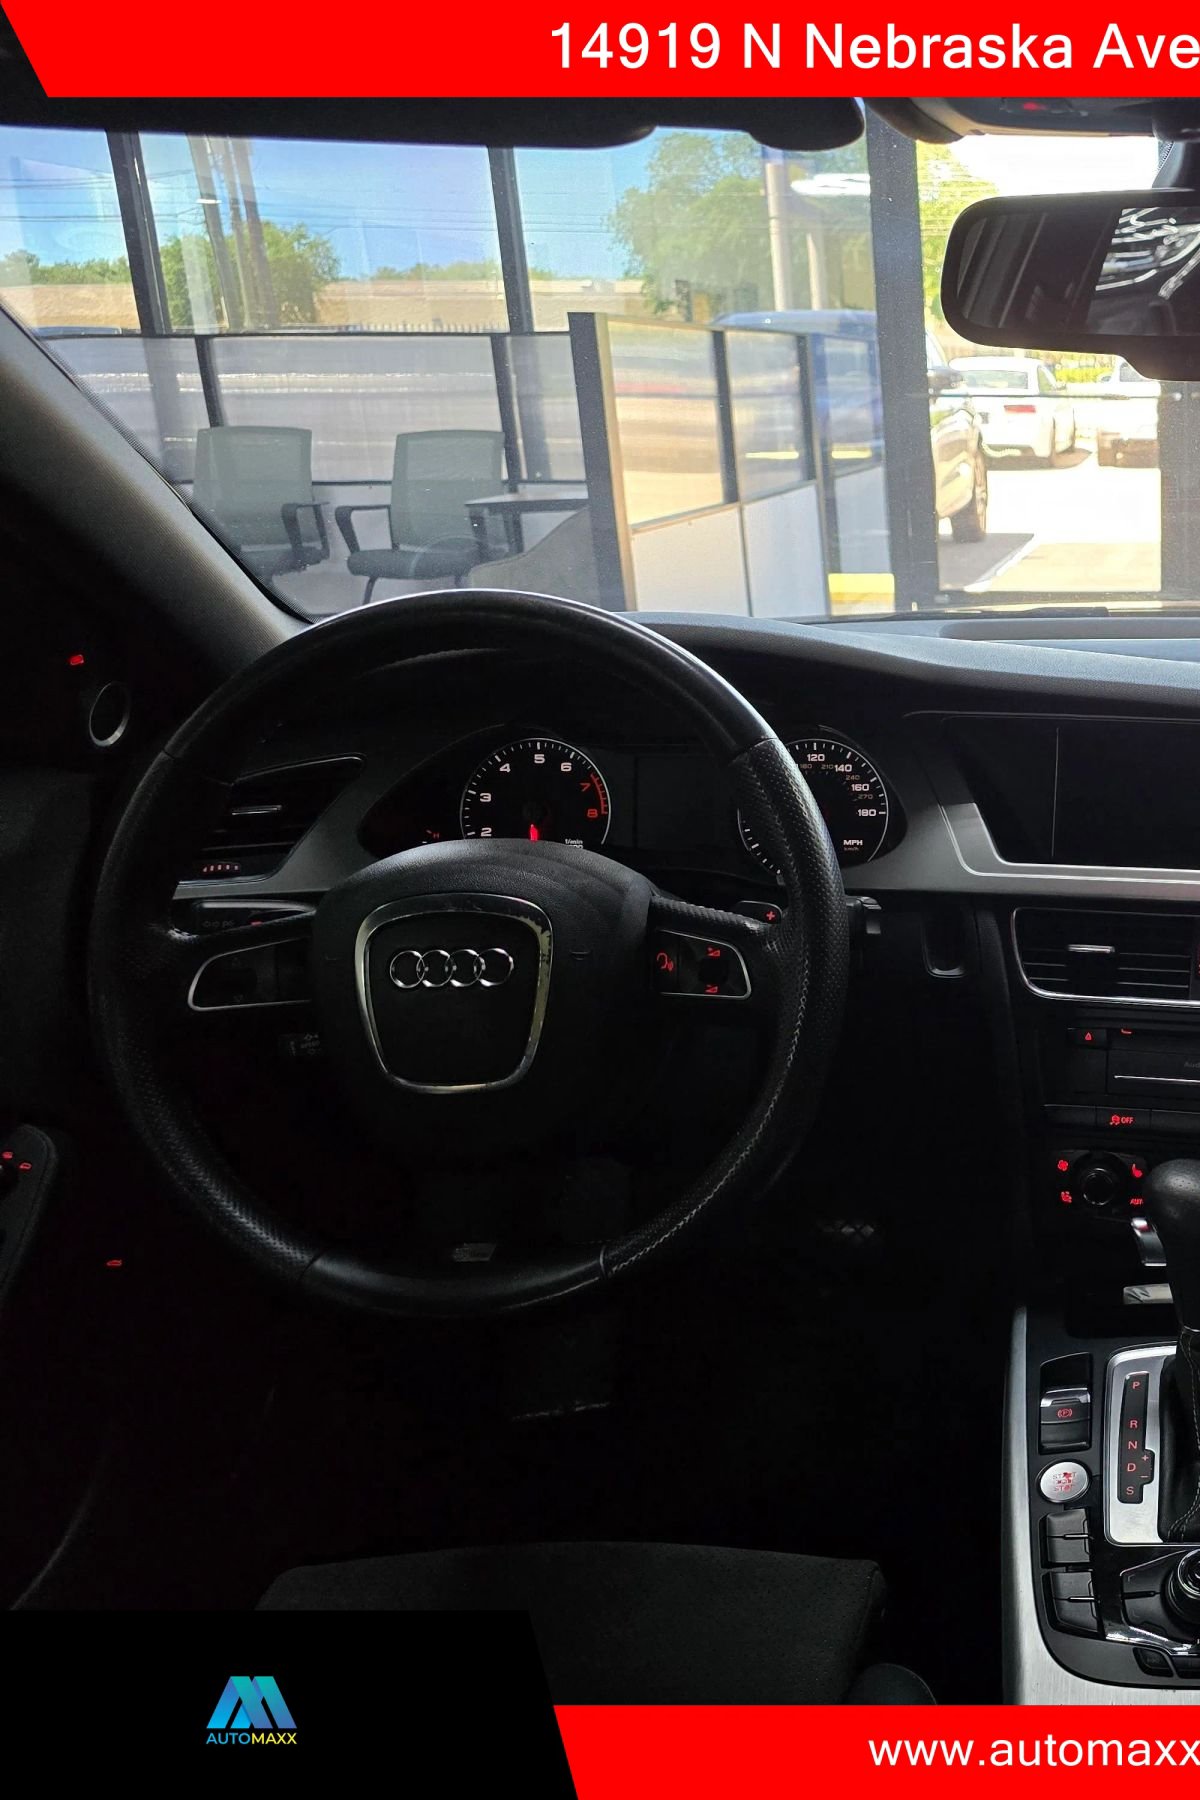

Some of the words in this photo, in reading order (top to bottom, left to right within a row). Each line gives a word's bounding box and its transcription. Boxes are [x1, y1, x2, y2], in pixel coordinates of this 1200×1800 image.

[534, 754, 545, 764] 5
[806, 753, 825, 762] 120
[499, 763, 510, 772] 4
[560, 763, 571, 772] 6
[835, 763, 853, 773] 140
[579, 783, 590, 791] 7
[851, 783, 870, 792] 160
[480, 793, 491, 802] 3
[587, 809, 597, 818] 8
[858, 808, 877, 817] 180
[481, 828, 492, 837] 2
[1120, 1116, 1134, 1125] OFF
[1132, 1381, 1140, 1389] P
[1130, 1420, 1137, 1428] R
[1128, 1441, 1137, 1449] N
[1127, 1463, 1136, 1472] D
[1126, 1487, 1134, 1495] S
